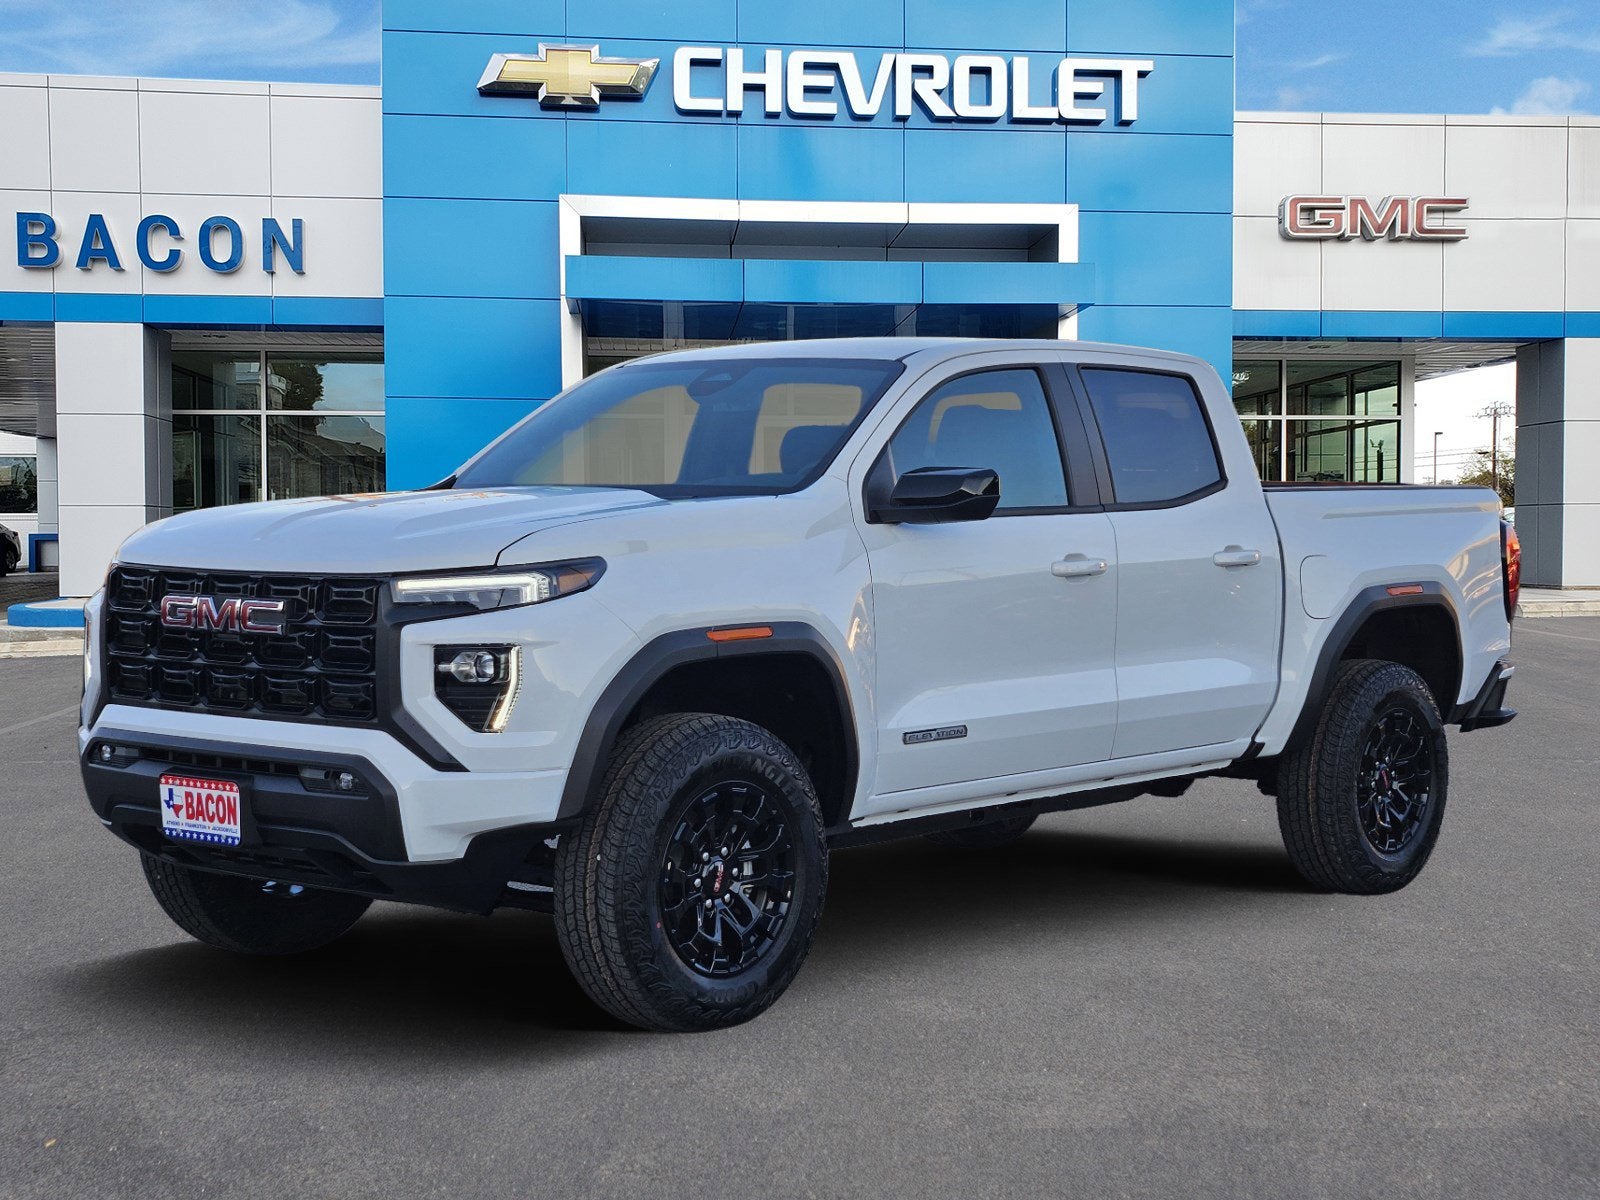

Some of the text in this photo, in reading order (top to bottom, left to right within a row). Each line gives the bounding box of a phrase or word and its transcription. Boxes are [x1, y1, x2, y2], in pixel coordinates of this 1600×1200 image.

[673, 46, 1154, 125] CHEVROLET
[1279, 194, 1469, 240] GMC
[16, 211, 305, 274] BACON
[160, 595, 284, 635] GMC
[907, 728, 965, 742] ELEVATION
[184, 791, 237, 826] BACON
